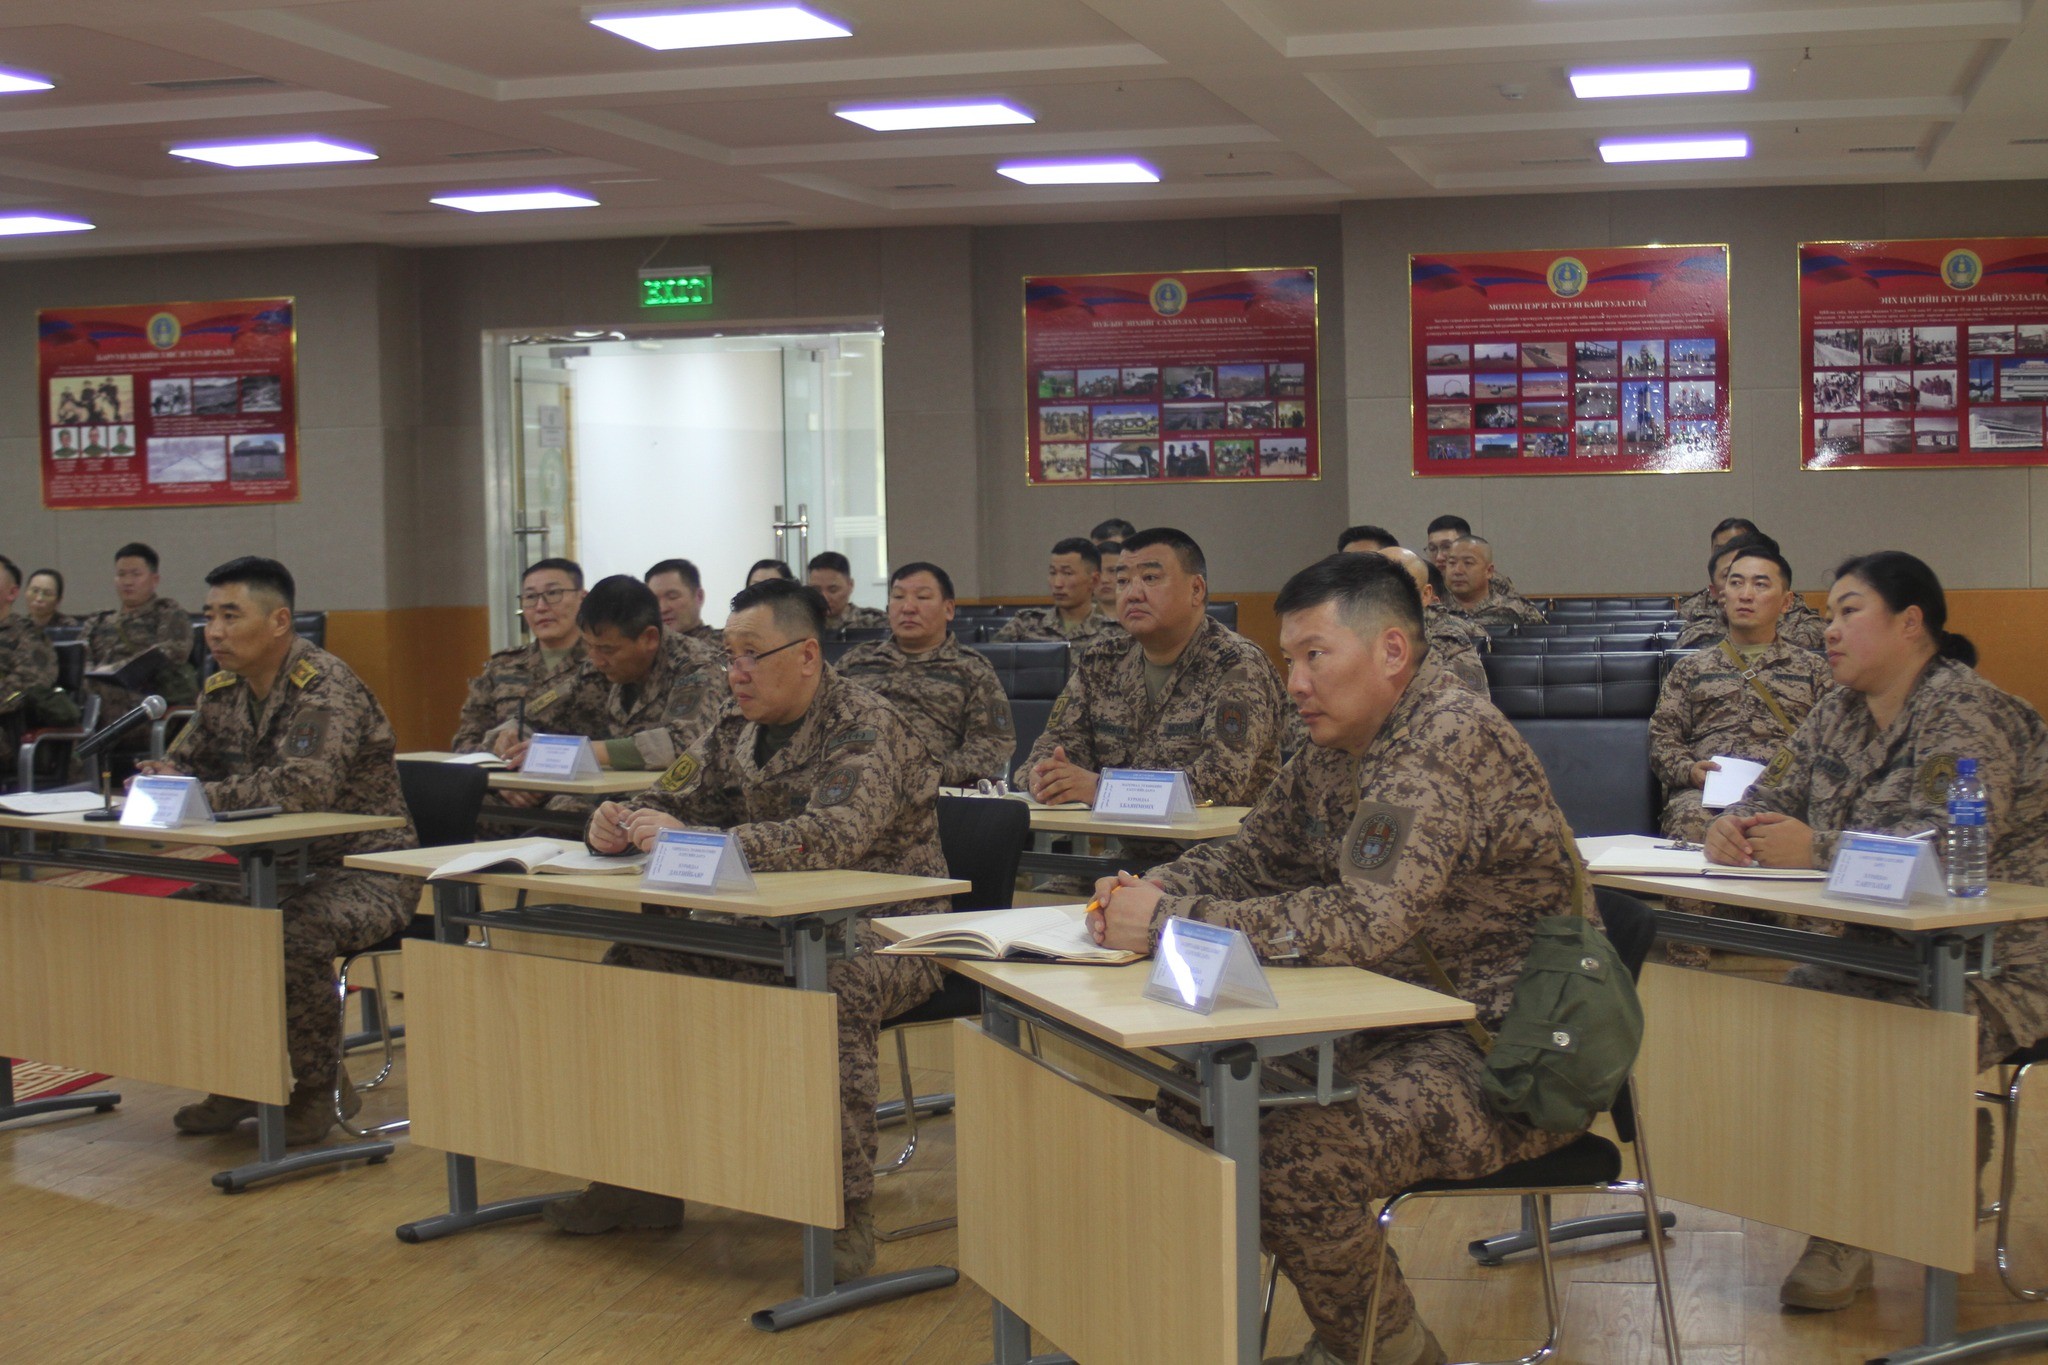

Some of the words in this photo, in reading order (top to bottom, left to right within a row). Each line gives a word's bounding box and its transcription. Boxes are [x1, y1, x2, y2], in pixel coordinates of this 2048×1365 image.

[1900, 294, 1939, 304] ЦАГИЙН
[1941, 294, 1977, 303] БҮТЭЭН
[1488, 302, 1523, 311] МОНГОЛ
[1524, 302, 1548, 310] ЦЭРЭГ
[1551, 301, 1582, 310] БҮТЭЭН
[1584, 299, 1648, 309] БАЙГУУЛАЛТАД
